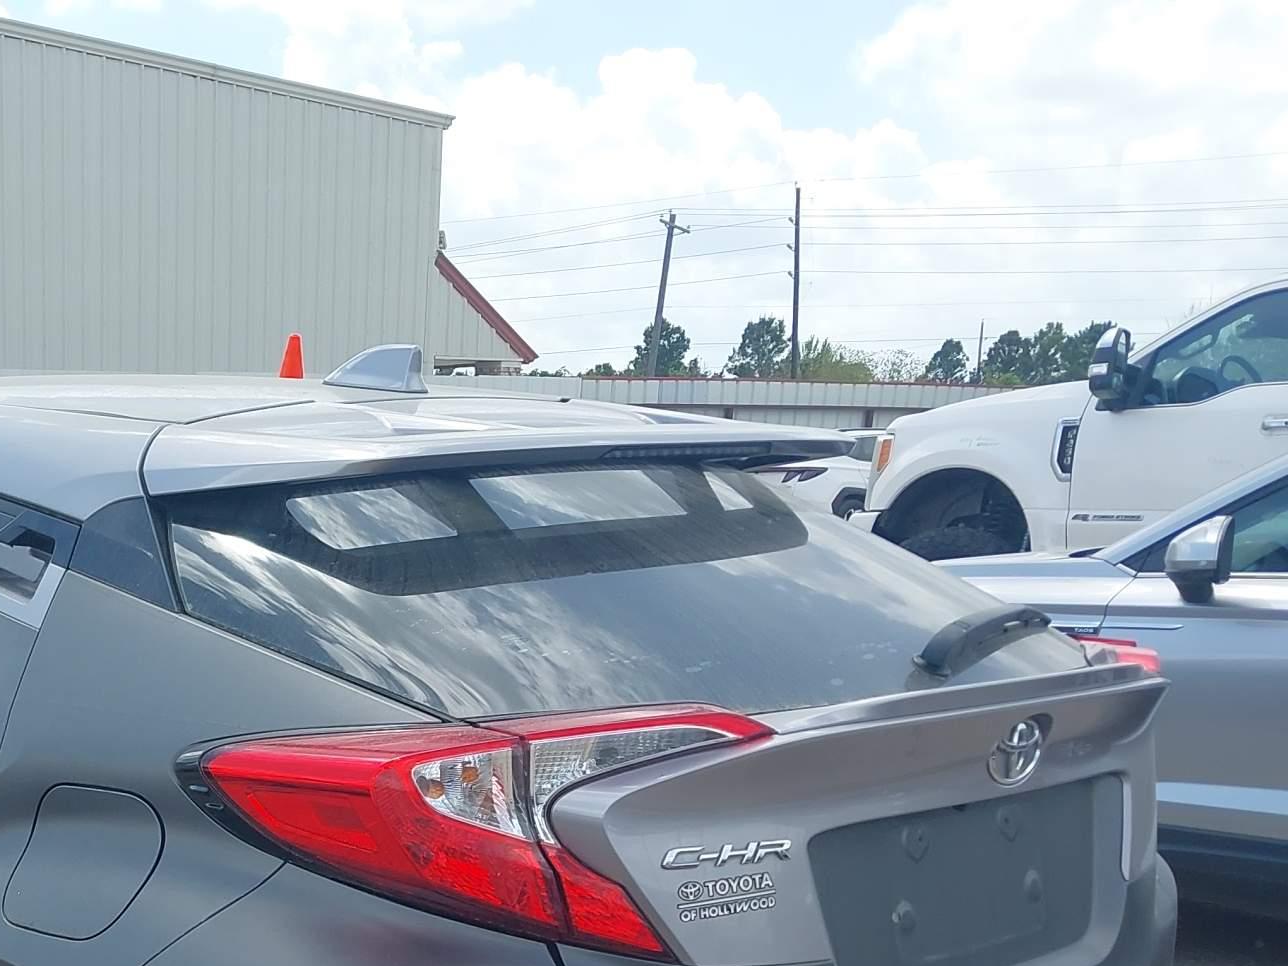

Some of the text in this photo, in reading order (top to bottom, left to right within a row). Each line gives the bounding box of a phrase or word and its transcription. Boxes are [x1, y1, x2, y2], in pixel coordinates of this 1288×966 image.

[661, 839, 792, 870] C-HR
[704, 872, 774, 898] TOYOTA
[680, 896, 776, 922] OF HOLLYWOOD
